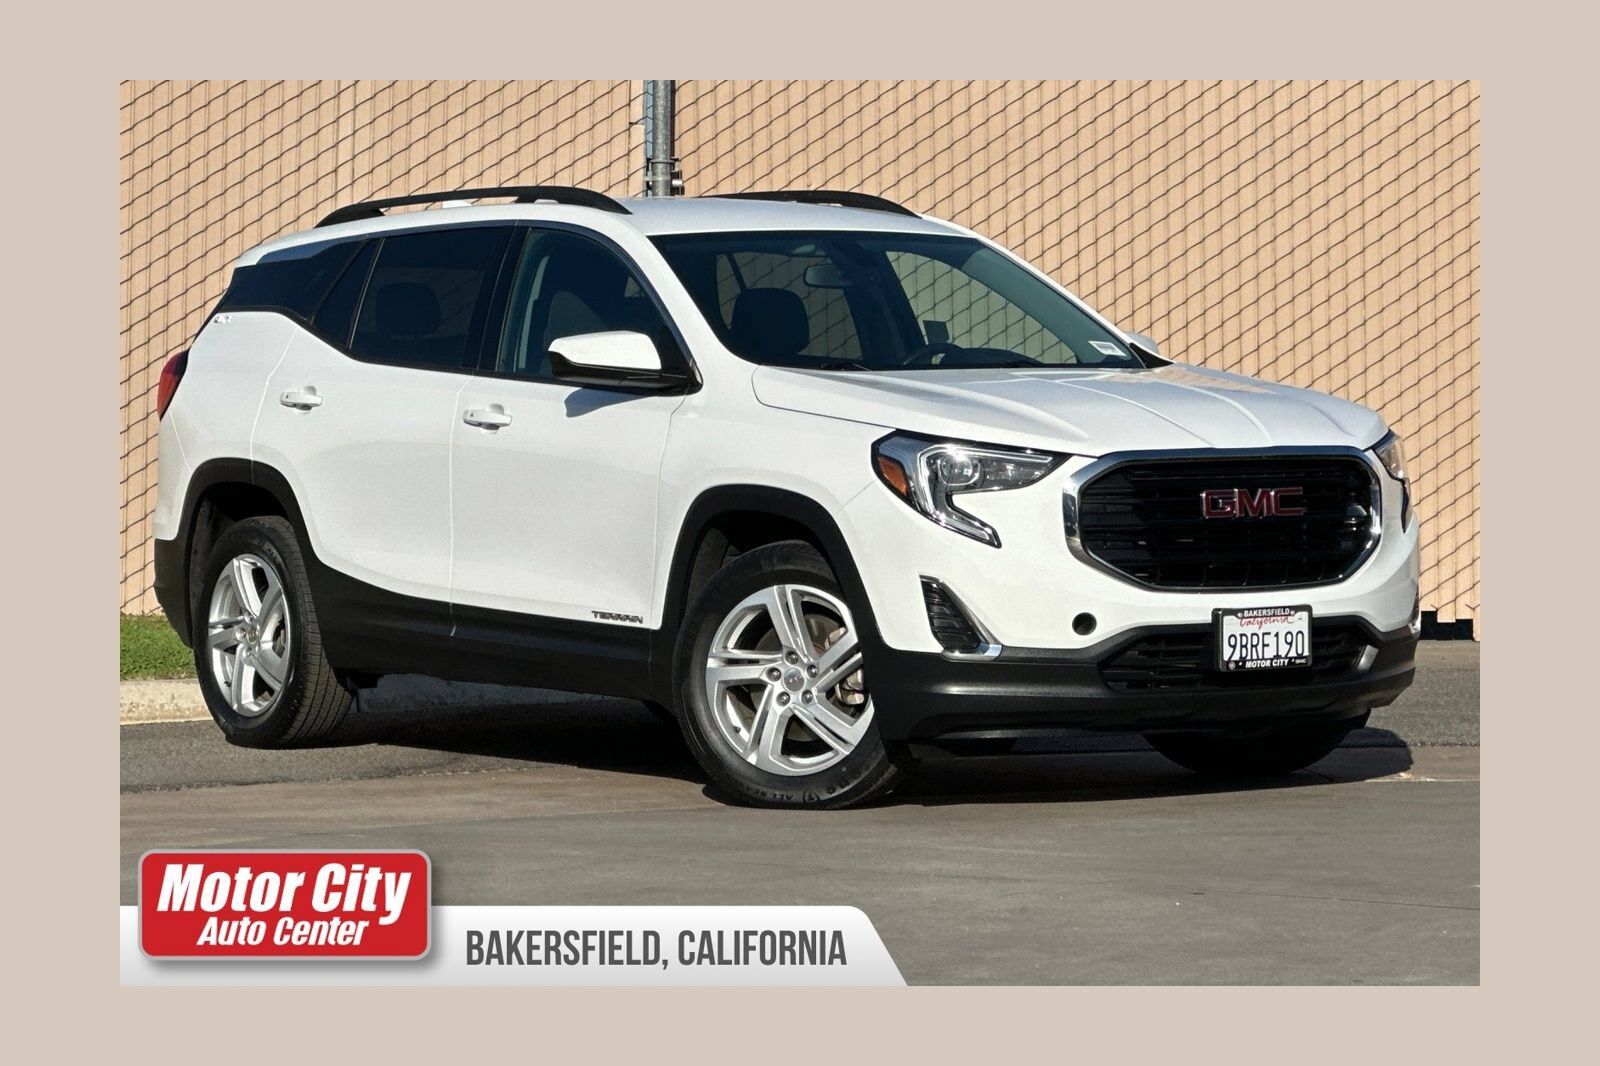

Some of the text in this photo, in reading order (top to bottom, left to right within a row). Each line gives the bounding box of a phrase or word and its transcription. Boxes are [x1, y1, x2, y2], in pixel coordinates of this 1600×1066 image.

[1200, 487, 1304, 518] GMC
[591, 610, 643, 624] TERRAIN
[1243, 608, 1290, 617] BAKERSFIELD
[1239, 616, 1295, 629] California
[1227, 630, 1305, 661] 9BRF190
[1245, 658, 1290, 669] MOTOR CITY
